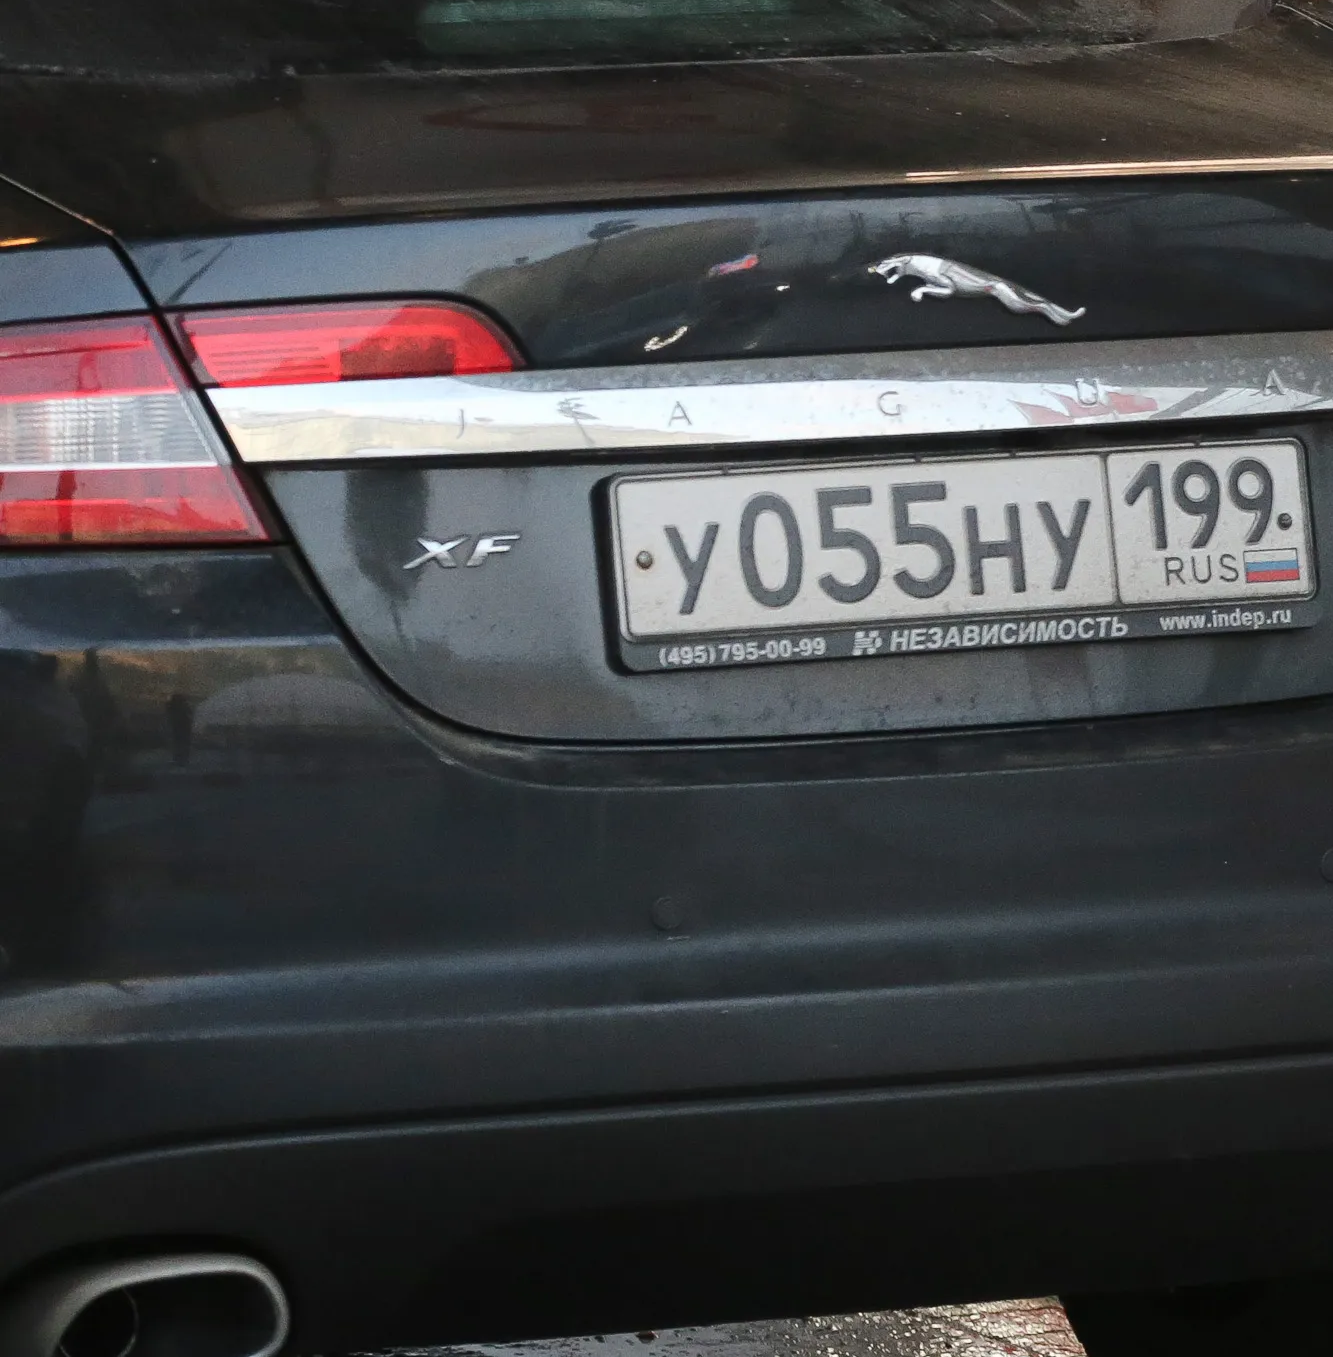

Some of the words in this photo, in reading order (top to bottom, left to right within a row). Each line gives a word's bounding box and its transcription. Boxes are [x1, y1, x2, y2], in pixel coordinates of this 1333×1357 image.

[403, 531, 521, 570] XF
[664, 480, 1091, 615] У055НУ
[1123, 456, 1275, 550] 199
[1164, 553, 1240, 586] RUS
[889, 614, 1129, 652] НЕЗАВИСИМОСТЬ
[1159, 607, 1292, 634] www.indep.ru
[659, 644, 716, 666] (495)
[717, 637, 827, 662] 795-00-99
